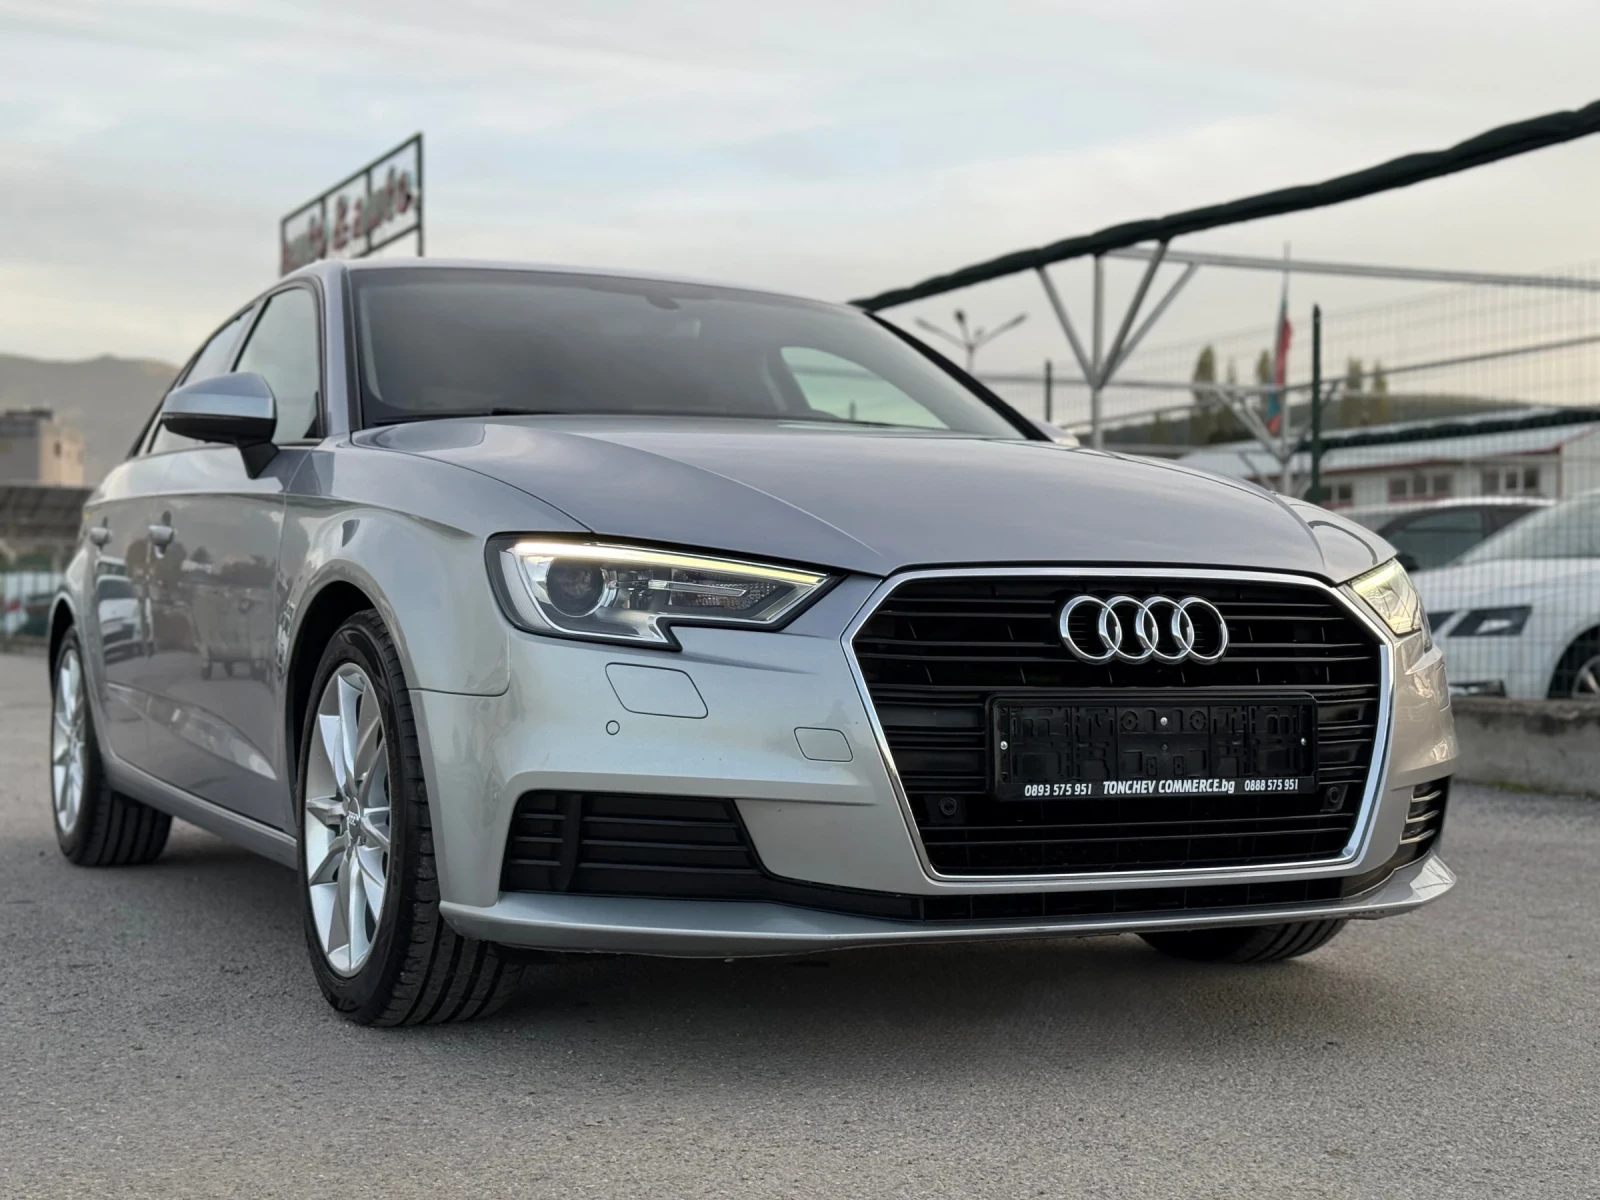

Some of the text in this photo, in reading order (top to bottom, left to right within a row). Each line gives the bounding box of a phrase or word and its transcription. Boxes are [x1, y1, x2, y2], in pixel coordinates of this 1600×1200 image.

[1025, 778, 1299, 796] 0893 575 951 TONCHEV COMMERCE.bg 0888 575 951
